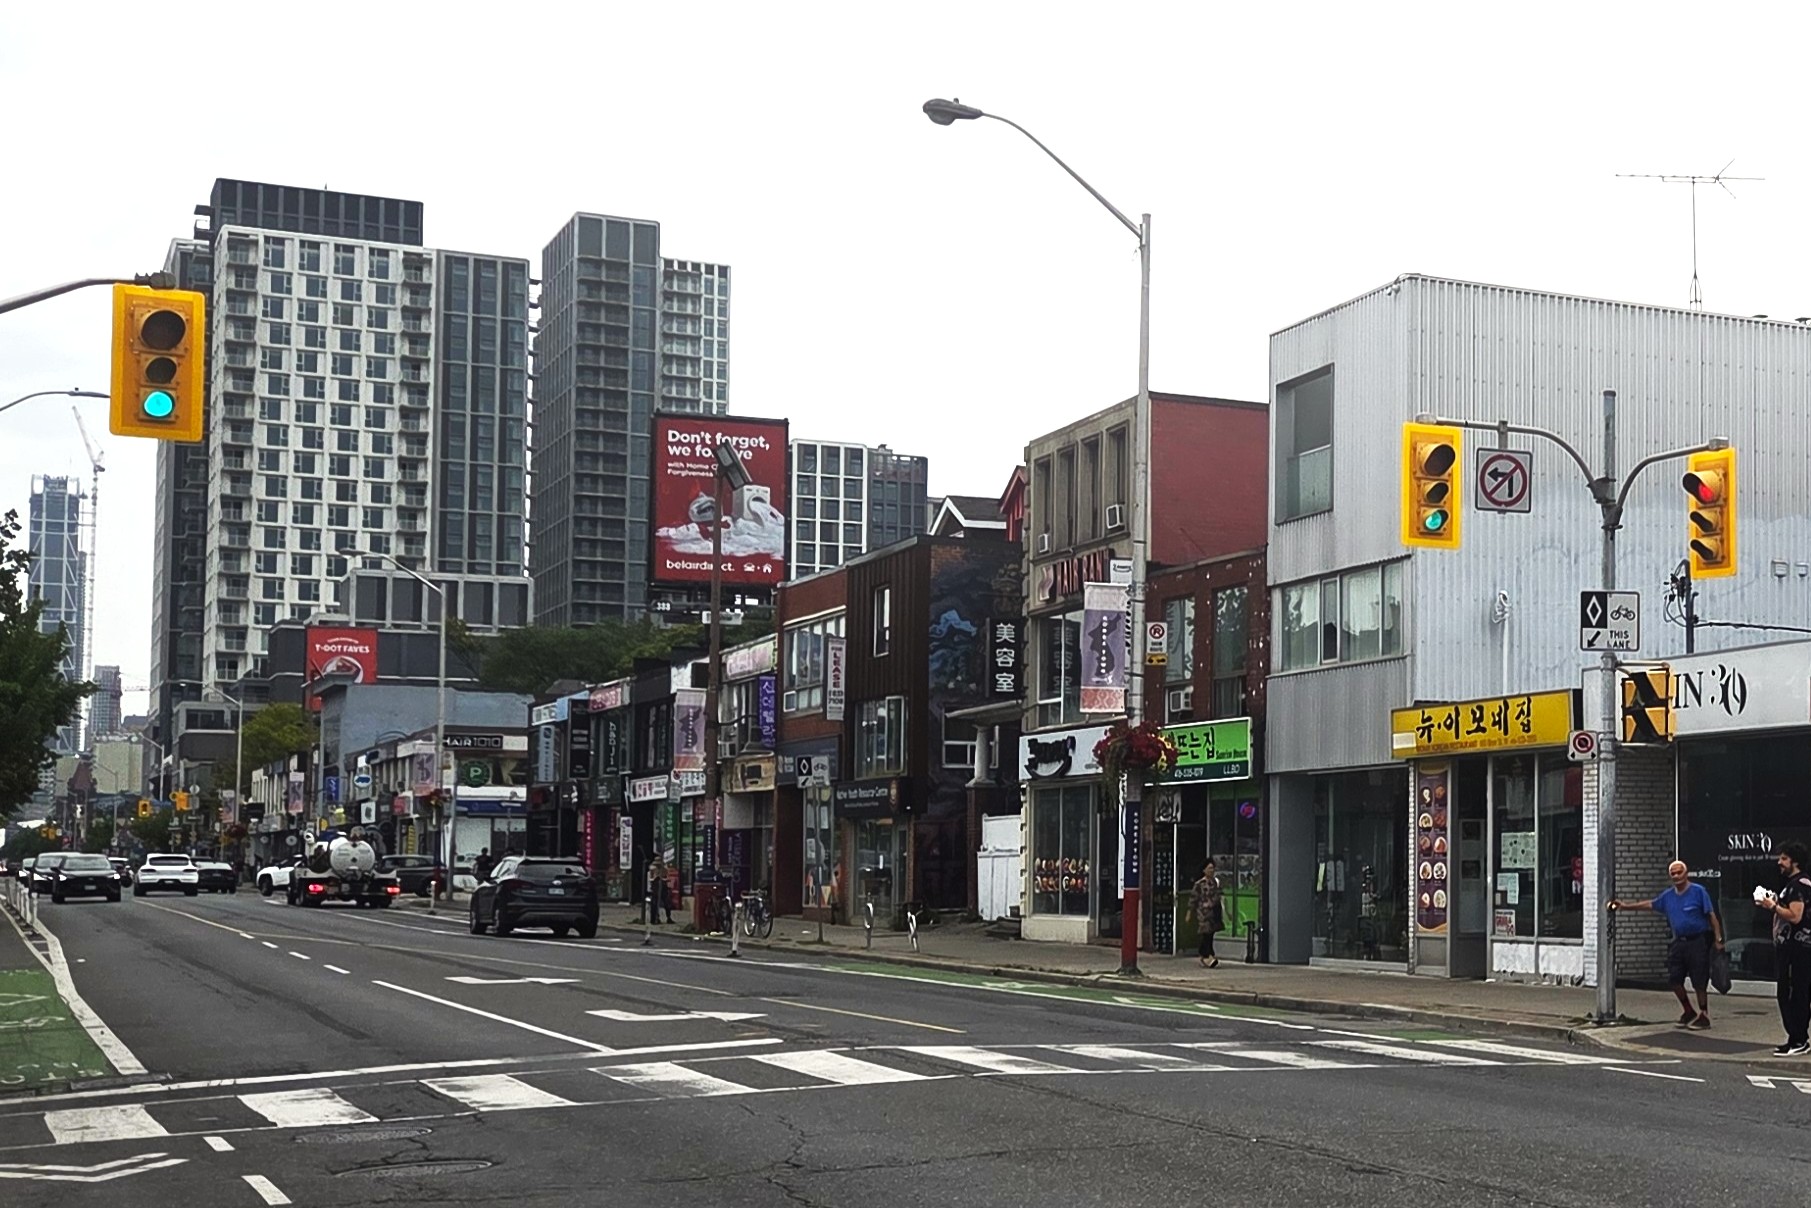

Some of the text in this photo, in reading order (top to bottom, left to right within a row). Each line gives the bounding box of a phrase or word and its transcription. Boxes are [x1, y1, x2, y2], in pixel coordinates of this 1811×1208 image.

[667, 430, 769, 451] Don't forget,
[667, 444, 752, 460] we fove
[665, 559, 735, 572] belairdict.
[1609, 630, 1629, 639] THIS
[1607, 640, 1630, 650] LANE
[996, 623, 1015, 692] 美容室
[833, 651, 841, 688] LEASE
[1672, 671, 1703, 709] IN
[1168, 727, 1215, 760] 뜨는집
[1728, 834, 1755, 850] SKIN
